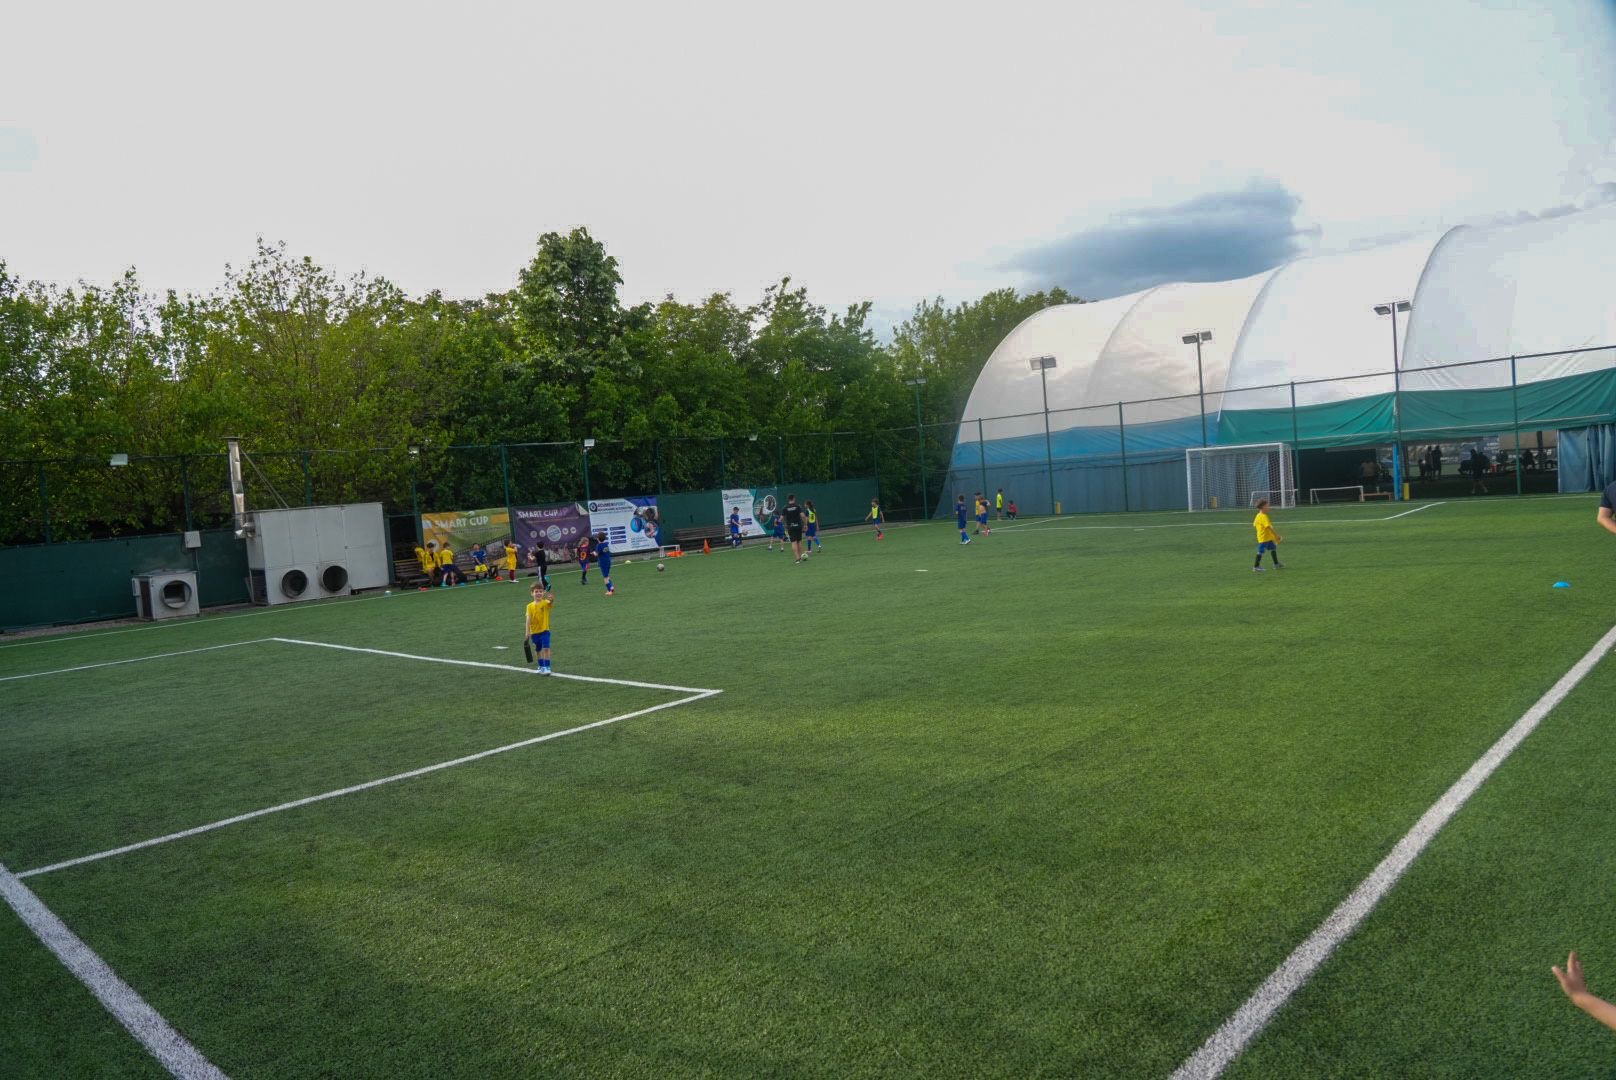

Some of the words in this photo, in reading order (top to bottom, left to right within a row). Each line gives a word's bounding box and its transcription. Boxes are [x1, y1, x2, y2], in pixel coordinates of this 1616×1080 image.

[517, 510, 542, 519] SMART
[434, 517, 467, 529] SMART
[469, 515, 489, 526] CUP
[580, 551, 587, 561] 9
